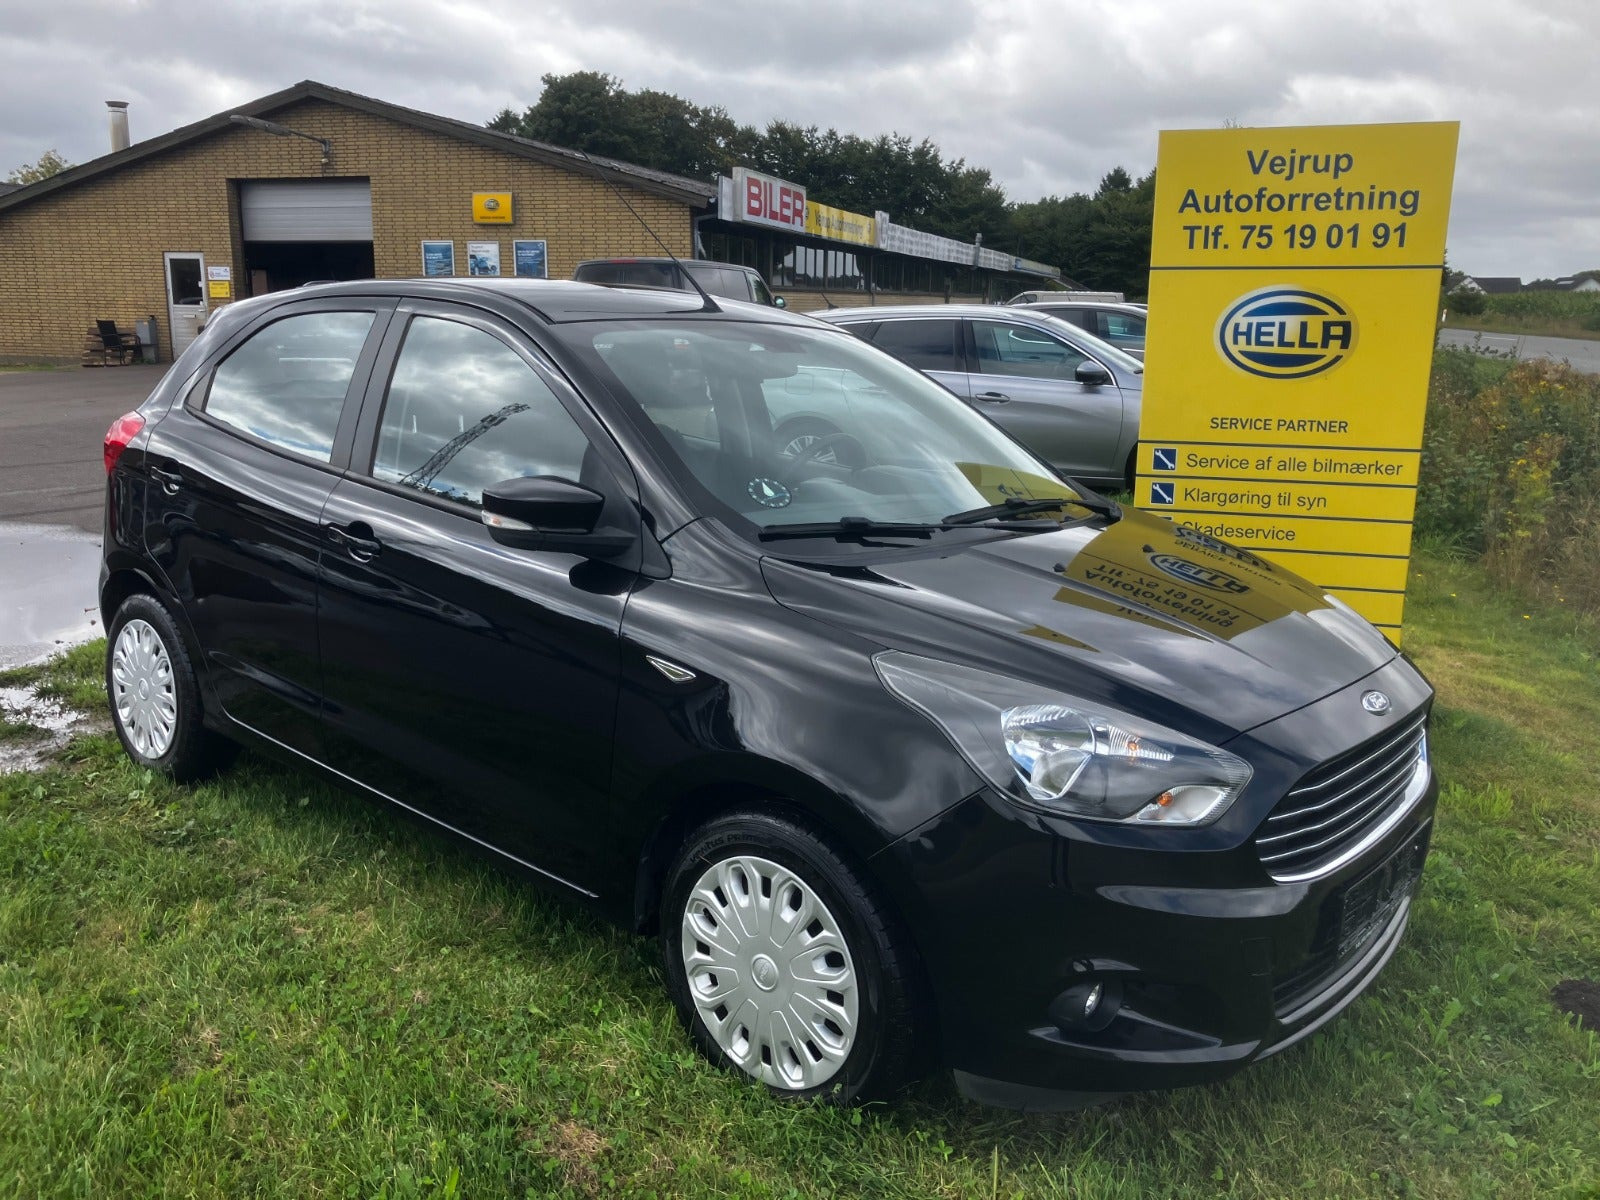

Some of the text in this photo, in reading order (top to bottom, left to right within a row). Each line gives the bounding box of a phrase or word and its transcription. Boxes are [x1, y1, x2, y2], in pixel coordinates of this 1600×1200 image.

[1247, 148, 1354, 181] Vejrup
[746, 176, 805, 228] BILER
[1178, 184, 1420, 217] Autoforretning
[1183, 222, 1407, 250] Tlf. 75 19 01 91
[1232, 320, 1351, 350] HELLA
[1210, 417, 1349, 433] SERVICE PARTNER
[1186, 453, 1403, 476] Service af alle bilmærker
[1184, 487, 1327, 511] Klargøring til syn
